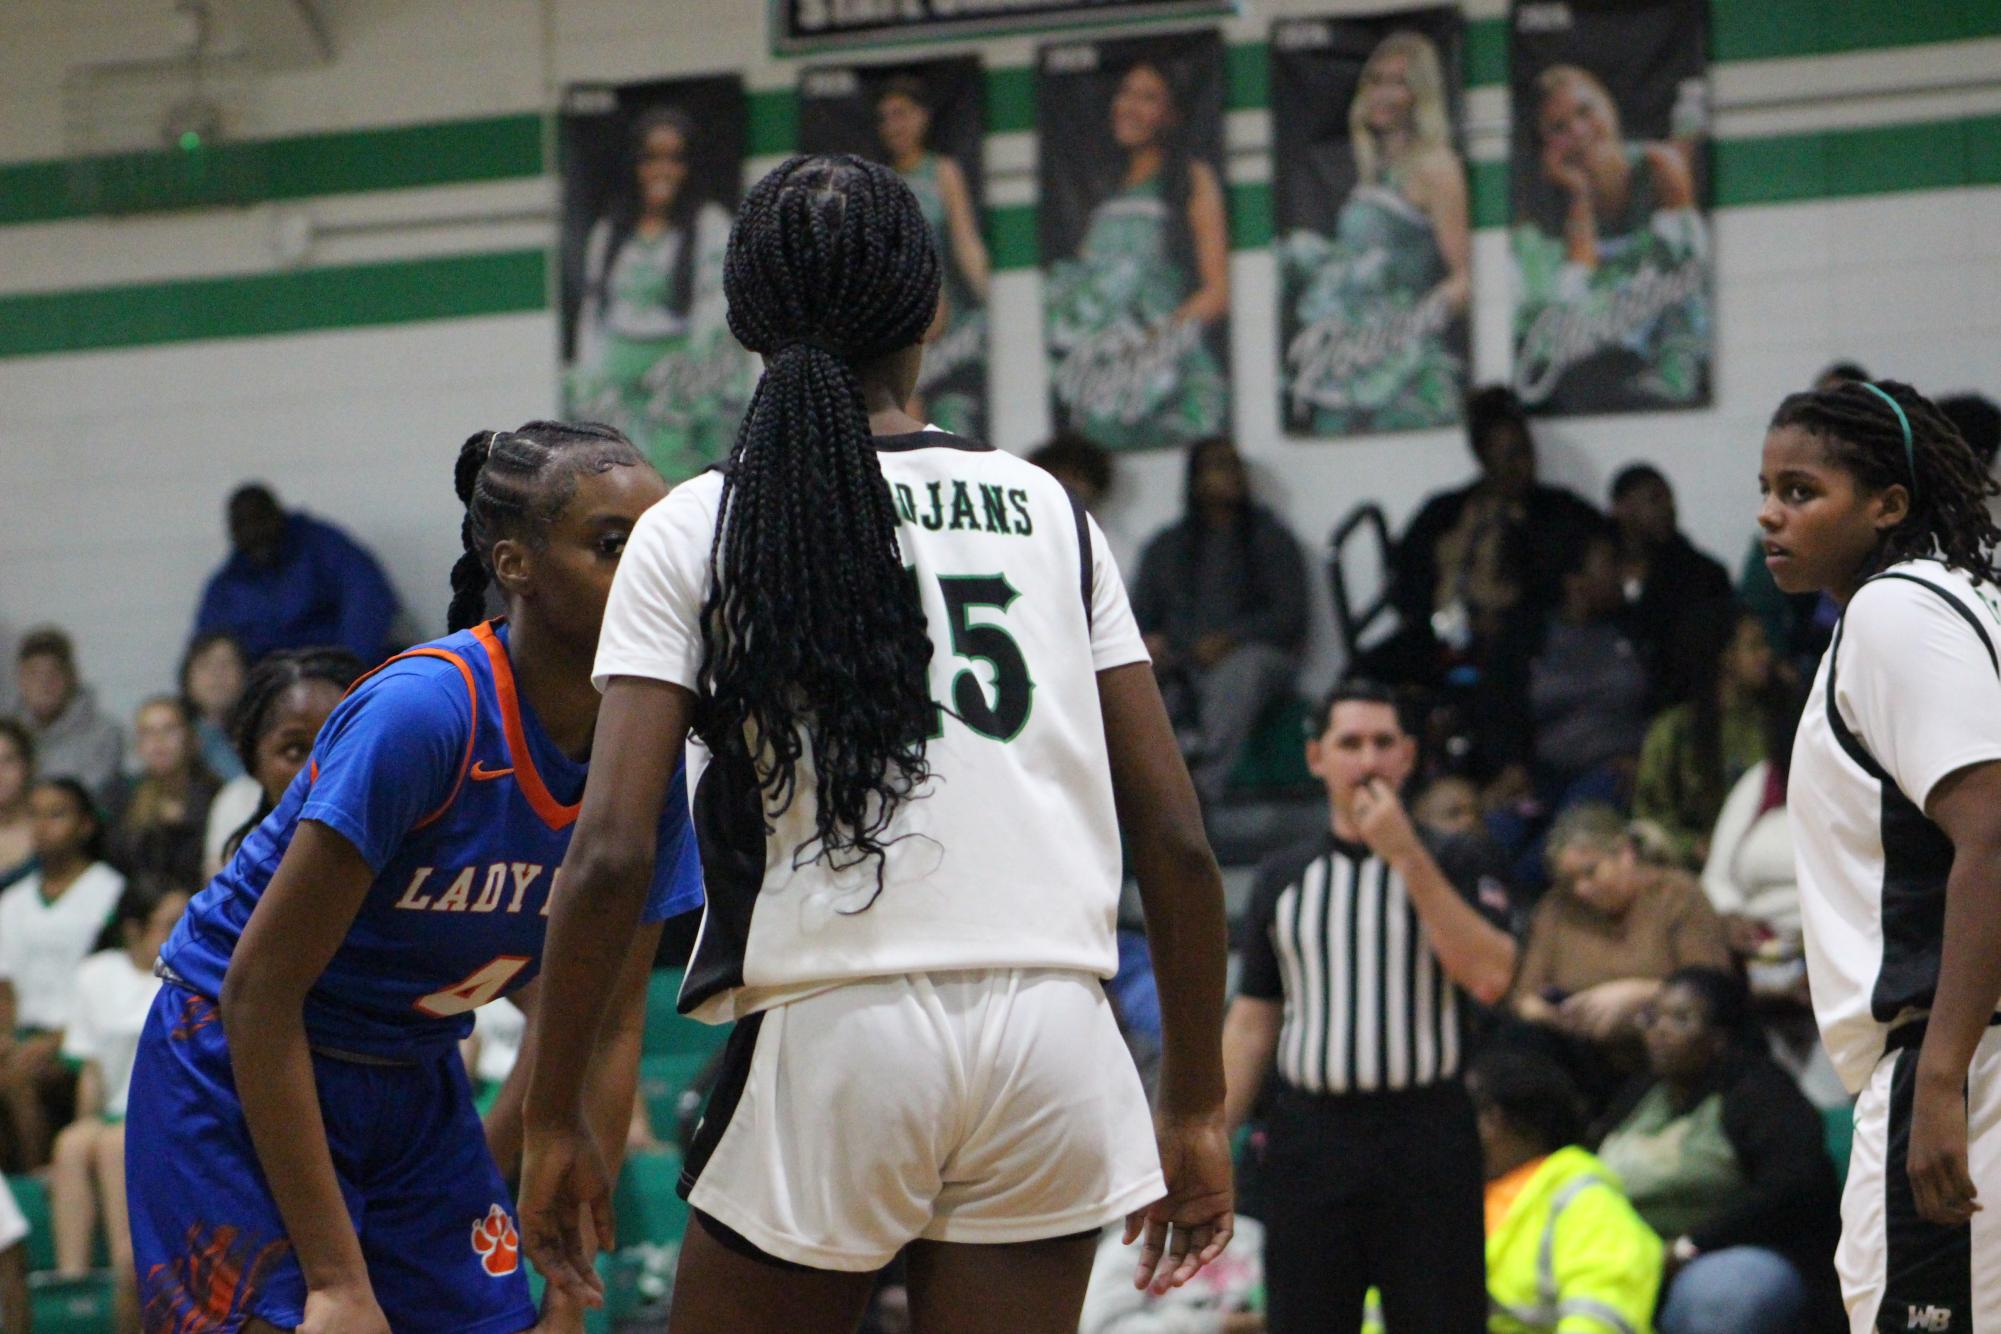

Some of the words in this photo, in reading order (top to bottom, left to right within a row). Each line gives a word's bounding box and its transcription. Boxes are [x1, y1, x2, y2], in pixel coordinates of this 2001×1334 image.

[394, 862, 543, 913] LADY
[411, 954, 532, 1019] 4
[1907, 1305, 1952, 1332] WB
